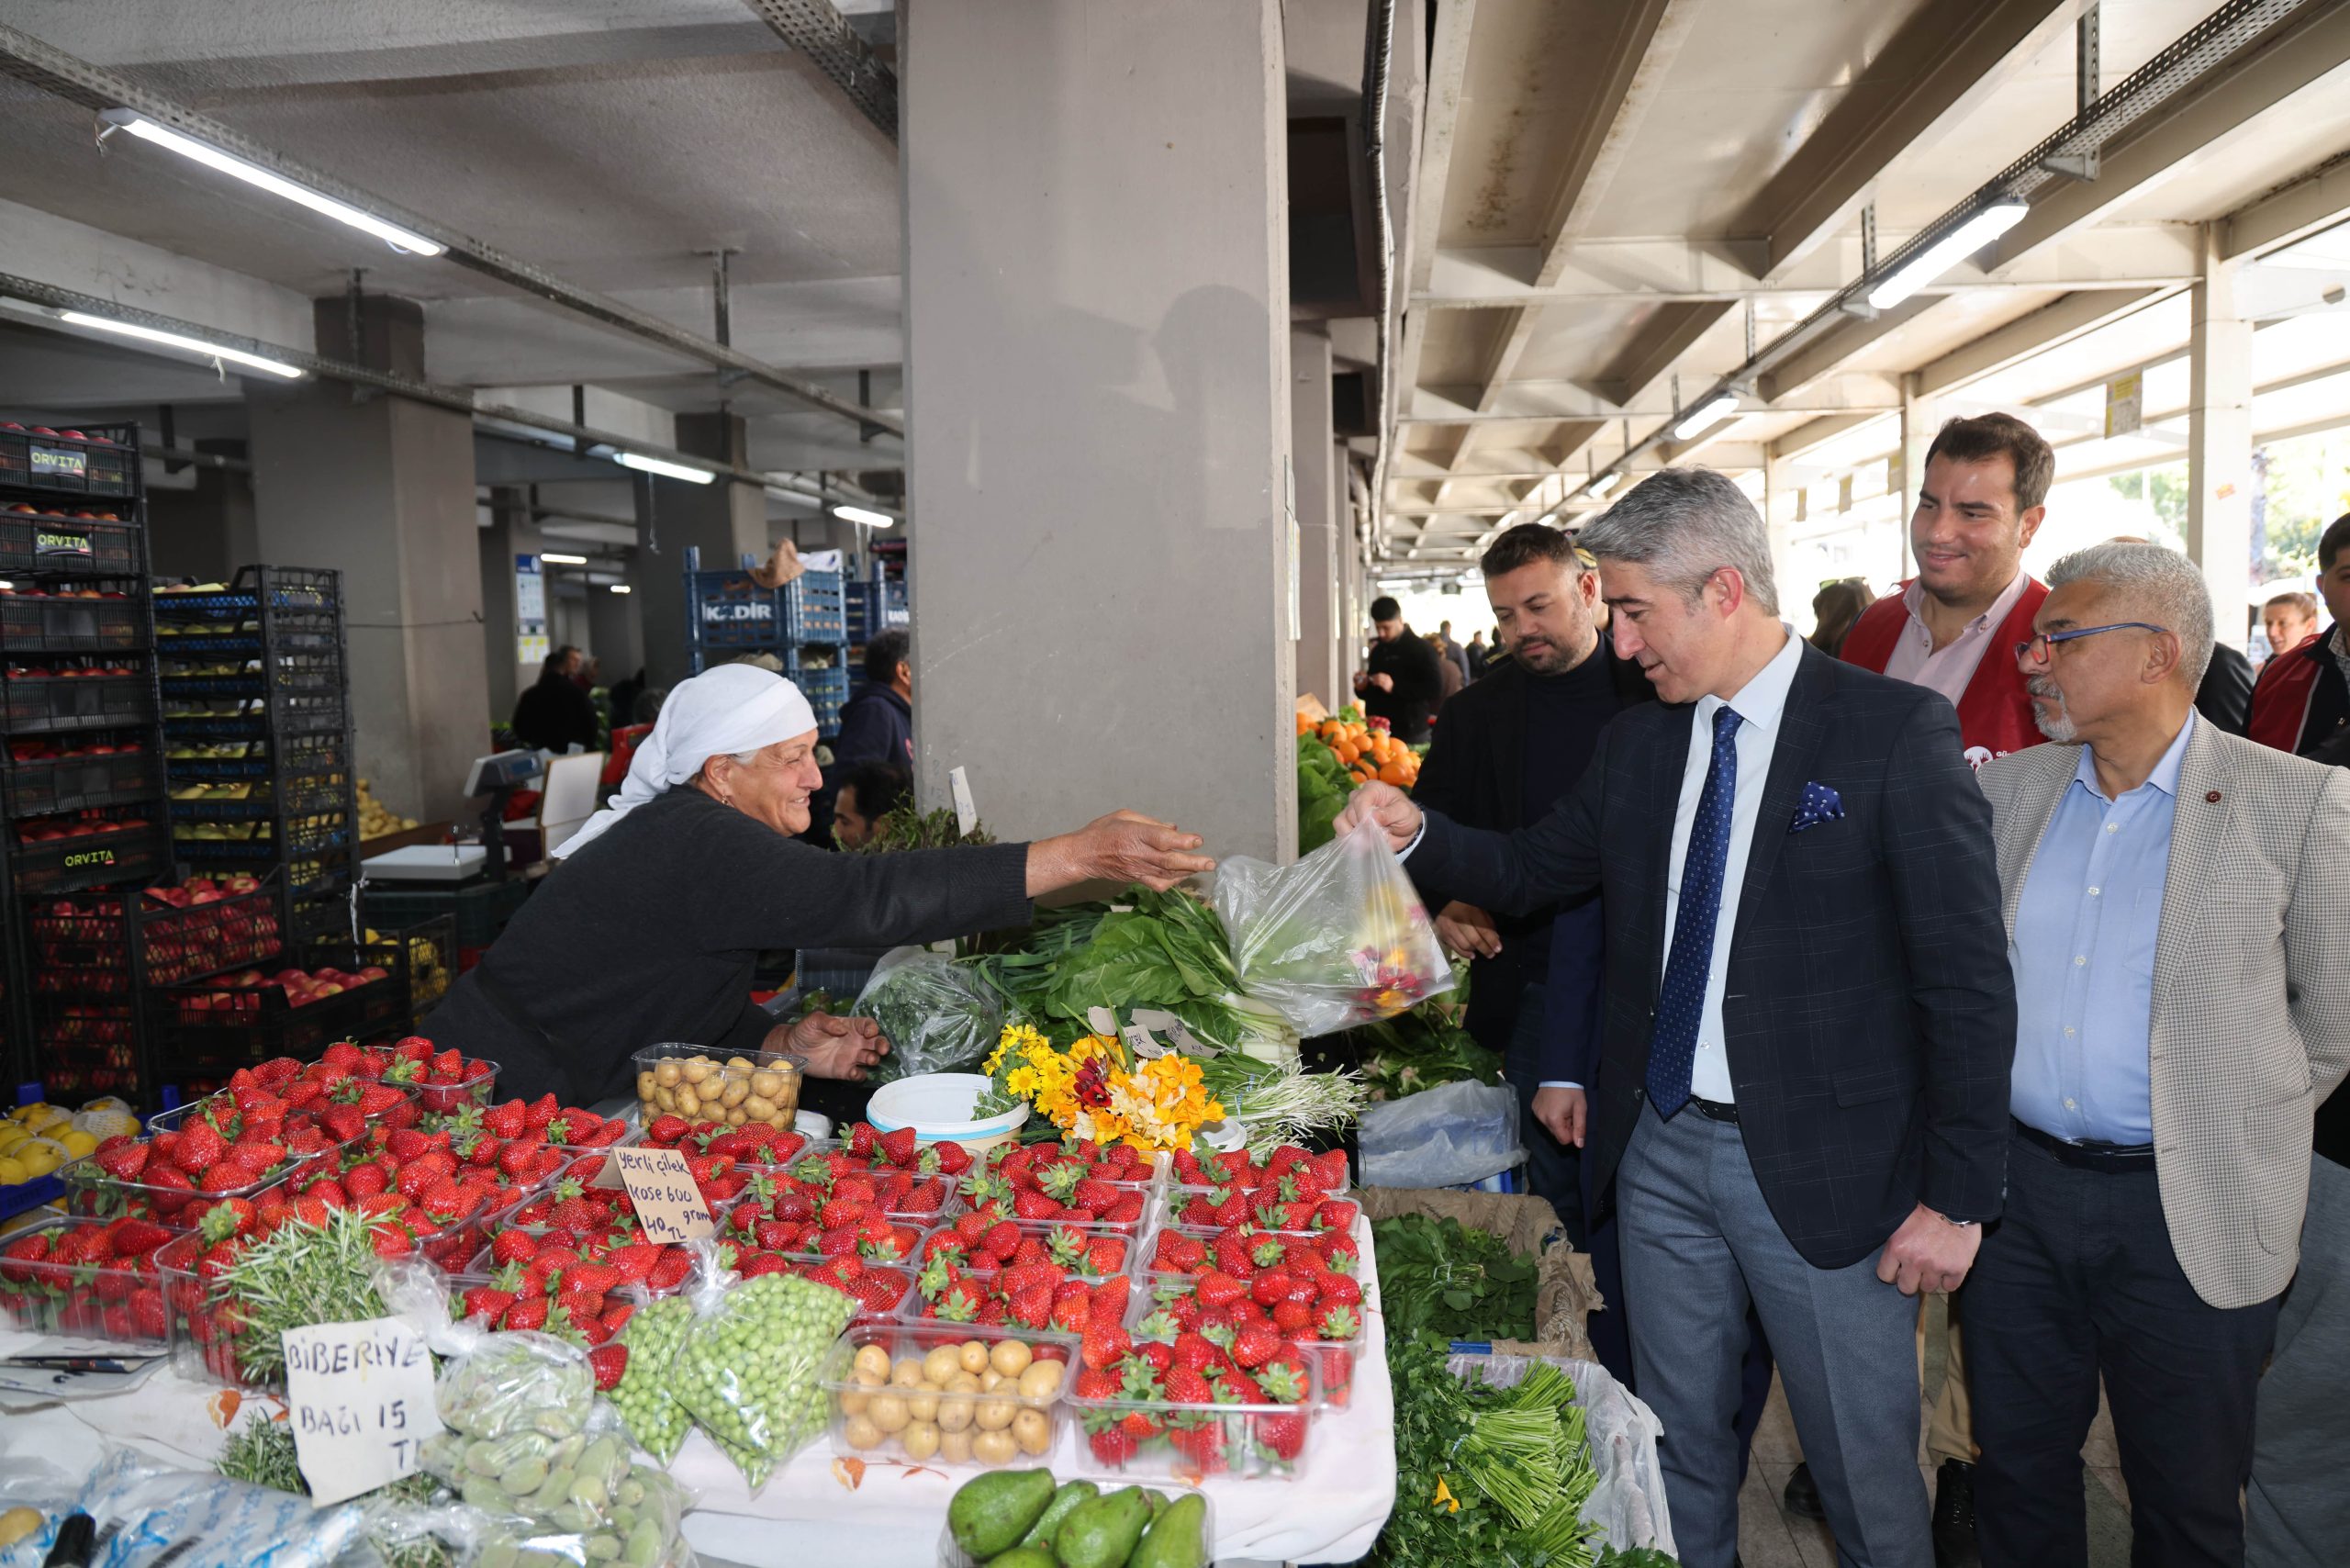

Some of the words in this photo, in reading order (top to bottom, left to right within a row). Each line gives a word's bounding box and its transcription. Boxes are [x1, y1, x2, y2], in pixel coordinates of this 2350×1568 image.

[31, 452, 84, 470] ORVITA
[38, 533, 89, 549] ORVITA
[64, 849, 115, 868] ORVITA
[666, 1186, 692, 1203] 600
[644, 1215, 666, 1235] 40
[667, 1226, 687, 1240] TL
[378, 1399, 407, 1429] 15
